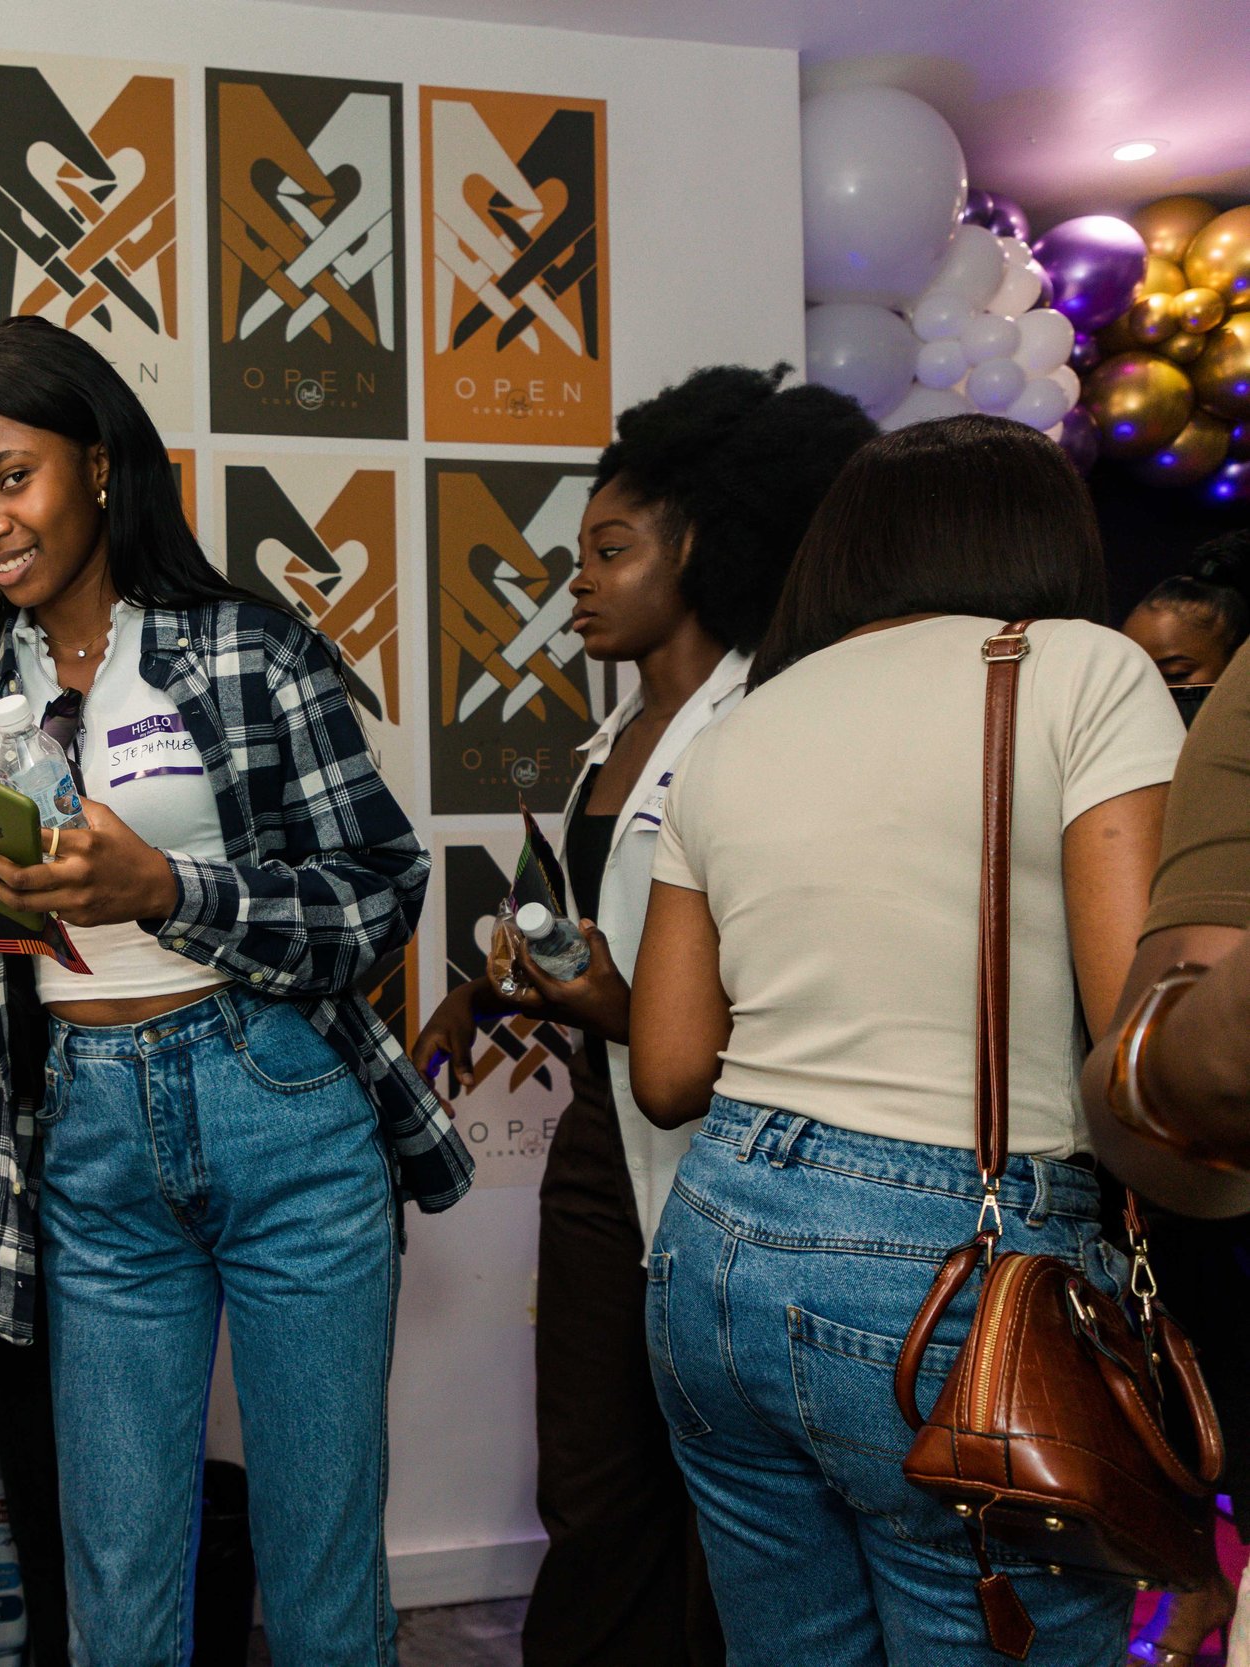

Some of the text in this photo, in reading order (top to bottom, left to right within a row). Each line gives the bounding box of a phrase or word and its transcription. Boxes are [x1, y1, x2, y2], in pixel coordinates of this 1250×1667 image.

[243, 367, 376, 393] OPEN
[455, 376, 582, 402] OPEN
[131, 716, 171, 735] HELLO
[468, 1118, 557, 1143] OPE
